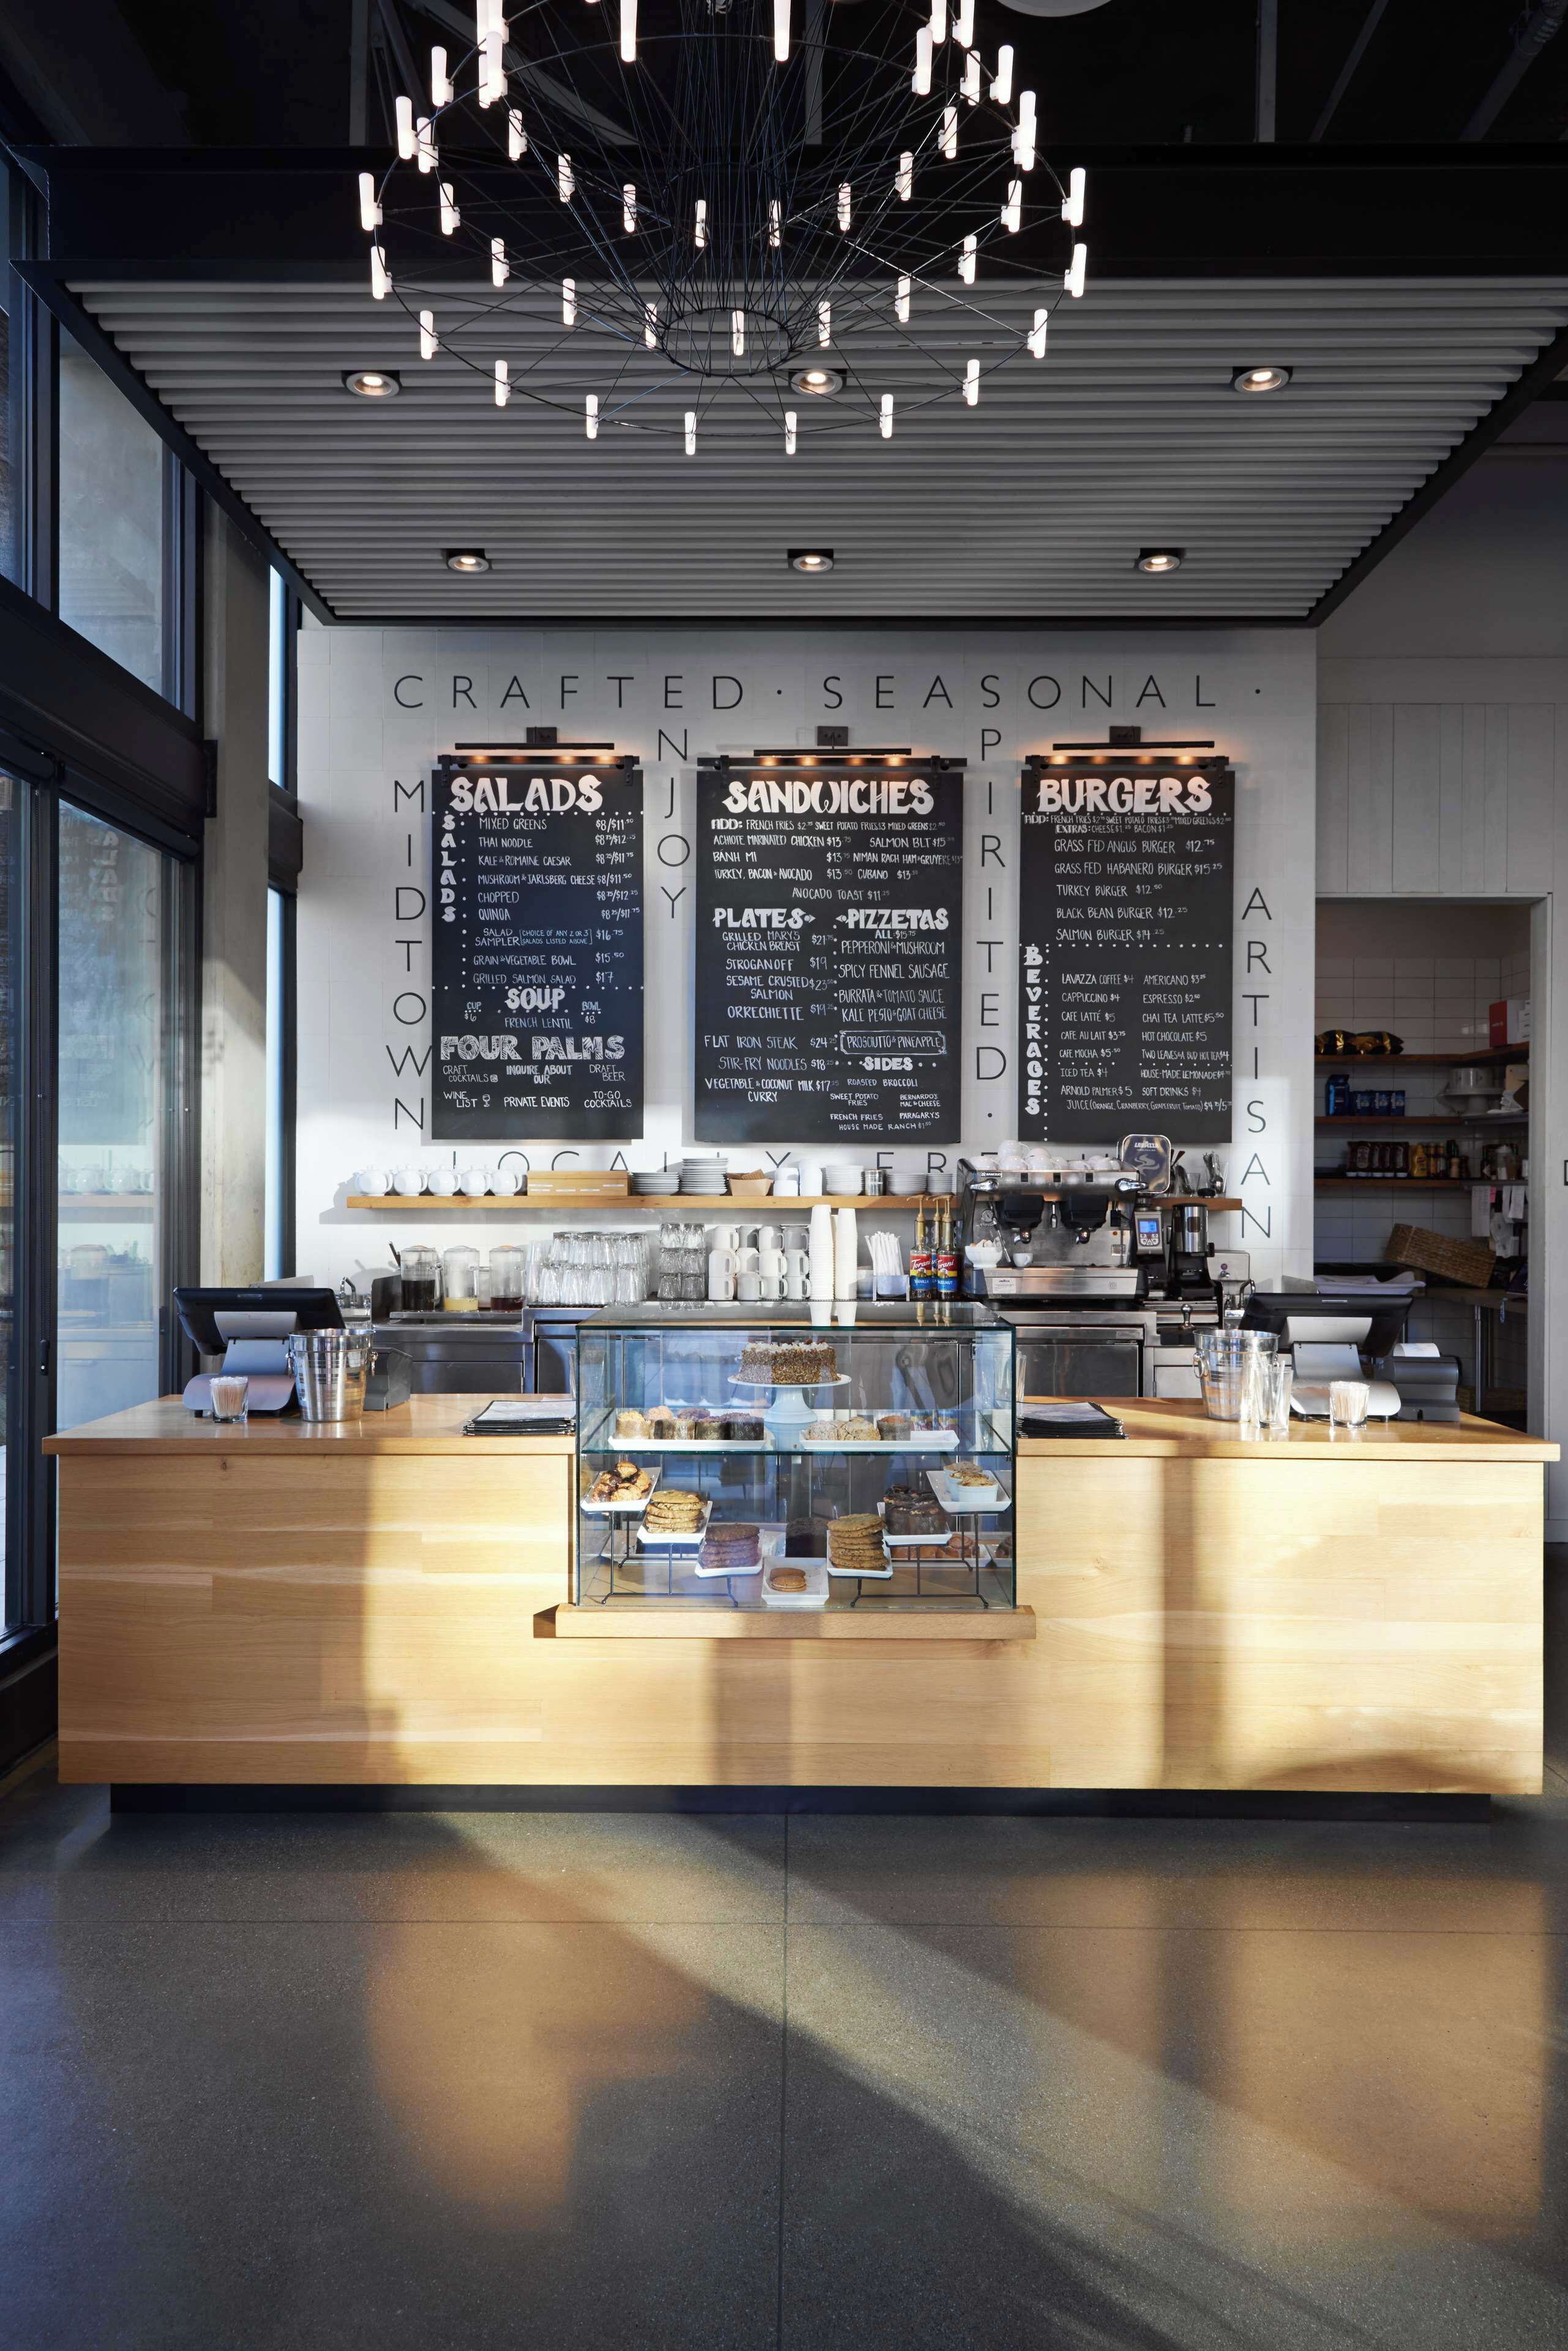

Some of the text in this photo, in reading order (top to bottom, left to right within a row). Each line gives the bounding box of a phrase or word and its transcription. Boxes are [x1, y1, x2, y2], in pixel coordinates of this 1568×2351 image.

[449, 774, 603, 812] SALADS
[721, 779, 934, 816] SANDWICHES
[1036, 776, 1213, 813] BURGERS
[479, 817, 547, 830] MIXED GREENS
[710, 818, 795, 831] ADD: FRENCH FRIES
[1055, 824, 1091, 834] EXTRAS:
[478, 837, 533, 848] THAI NOODLE
[790, 835, 825, 847] CHICKEN
[869, 837, 931, 848] SALMON BLT
[1054, 839, 1176, 853] GRASS FED ANGUS BURGER
[478, 855, 572, 866] KALE CAESAR
[853, 852, 879, 863] NIMAN
[748, 868, 812, 881] BACON AVOCADO
[858, 869, 888, 880] CUBANO
[1054, 862, 1193, 876] GRASS FED HABANERO BURGER
[478, 874, 595, 885] MUSHROOM CHEESE
[792, 887, 865, 901] AVOCADO TOAST
[1056, 884, 1128, 897] TURKEY BURGER
[478, 891, 519, 904] CHOPPED
[478, 909, 511, 921] QUINOA
[712, 907, 806, 929] PLATES
[845, 907, 949, 930] PIZZETAS
[1056, 907, 1153, 919] BLACK BEAN BURGER
[482, 928, 513, 937] SALAD
[722, 932, 762, 942] GRILLED
[1056, 929, 1135, 941] SALMON BURGER
[727, 941, 801, 951] CHICKEN BREAST
[386, 780, 432, 1130] MIDTOWN
[473, 955, 577, 966] GRAIN VEGETABLE BOWL
[809, 956, 827, 970] $19
[473, 970, 614, 984] GRILLED SALMON SALAD $17
[838, 963, 950, 979] SPICY FENNEL SAUSAGE
[726, 975, 809, 988] SESAME CRUSTED
[1062, 973, 1122, 985] LAVAZZA COFFEE
[1142, 975, 1189, 985] AMERICANO
[505, 988, 566, 1010] SOUP
[751, 988, 793, 1000] SALMON
[839, 988, 944, 1003] BURRATA SAUCE
[1062, 992, 1108, 1003] CAPPUCCINO
[1142, 994, 1183, 1004] ESPRESSO
[467, 1002, 482, 1010] CUP
[581, 1001, 601, 1011] BOWL
[584, 1015, 596, 1024] $8
[727, 1006, 805, 1021] ORRECHIETTE
[842, 1007, 948, 1022] KALE CHEESE
[1142, 1013, 1178, 1024] CHAI TEA
[505, 1017, 573, 1029] FRENCH LENTIL
[737, 1035, 798, 1049] IRON STEAK
[847, 1035, 941, 1049] PROSCIUTTO PINEAPPLE
[1156, 1032, 1195, 1041] CHOCOLATE
[440, 1035, 625, 1060] FOUR PALMS
[1075, 1049, 1098, 1058] MOCHA
[589, 1063, 616, 1073] DRAFT
[718, 1056, 807, 1071] STIR-FRY NOODLES
[862, 1056, 913, 1071] SIDES
[1240, 887, 1272, 1238] ARTISAN
[443, 1065, 468, 1075] CRAFT
[506, 1065, 572, 1076] INQUIRE ABOUT
[1080, 1068, 1095, 1077] TEA
[448, 1074, 489, 1082] COCKTAILS
[533, 1074, 552, 1085] OUR
[602, 1071, 626, 1082] BEER
[883, 1078, 918, 1087] BROCCOLI
[704, 1078, 794, 1090] VEGETABLE COCONUT
[443, 1091, 467, 1100] WINE
[1060, 1085, 1118, 1096] ARNOLD PALMER
[1142, 1087, 1189, 1097] SOFT DRINKS
[456, 1098, 478, 1108] LIST
[504, 1097, 570, 1108] PRIVATE EVENTS
[584, 1098, 632, 1108] COCKTAILS
[748, 1091, 778, 1103] CURRY
[1067, 1100, 1089, 1110] JUICE
[911, 1258, 931, 1270] Torani
[937, 1259, 955, 1269] Torani
